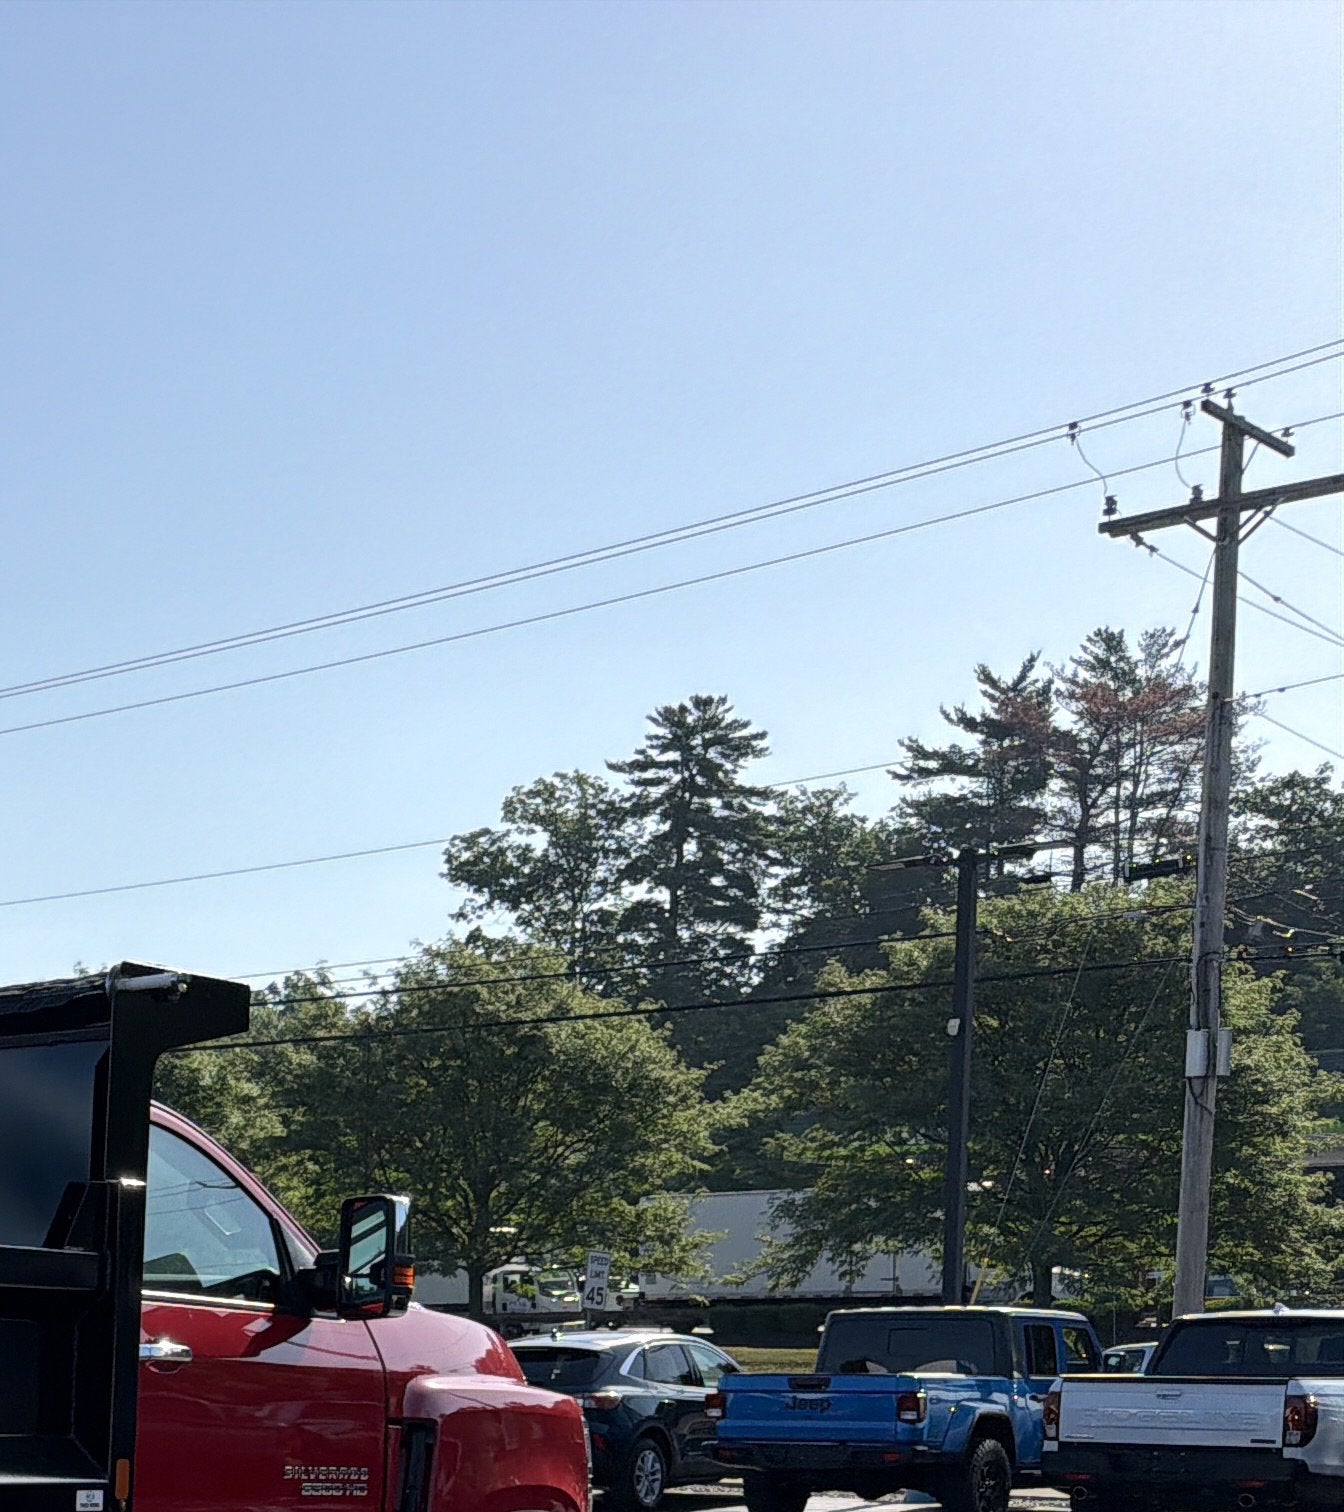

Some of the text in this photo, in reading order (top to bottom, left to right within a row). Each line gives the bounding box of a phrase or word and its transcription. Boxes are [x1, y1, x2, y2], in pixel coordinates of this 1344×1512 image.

[585, 1286, 605, 1306] 45
[784, 1395, 832, 1414] Jeep
[283, 1465, 369, 1480] SILVERADO
